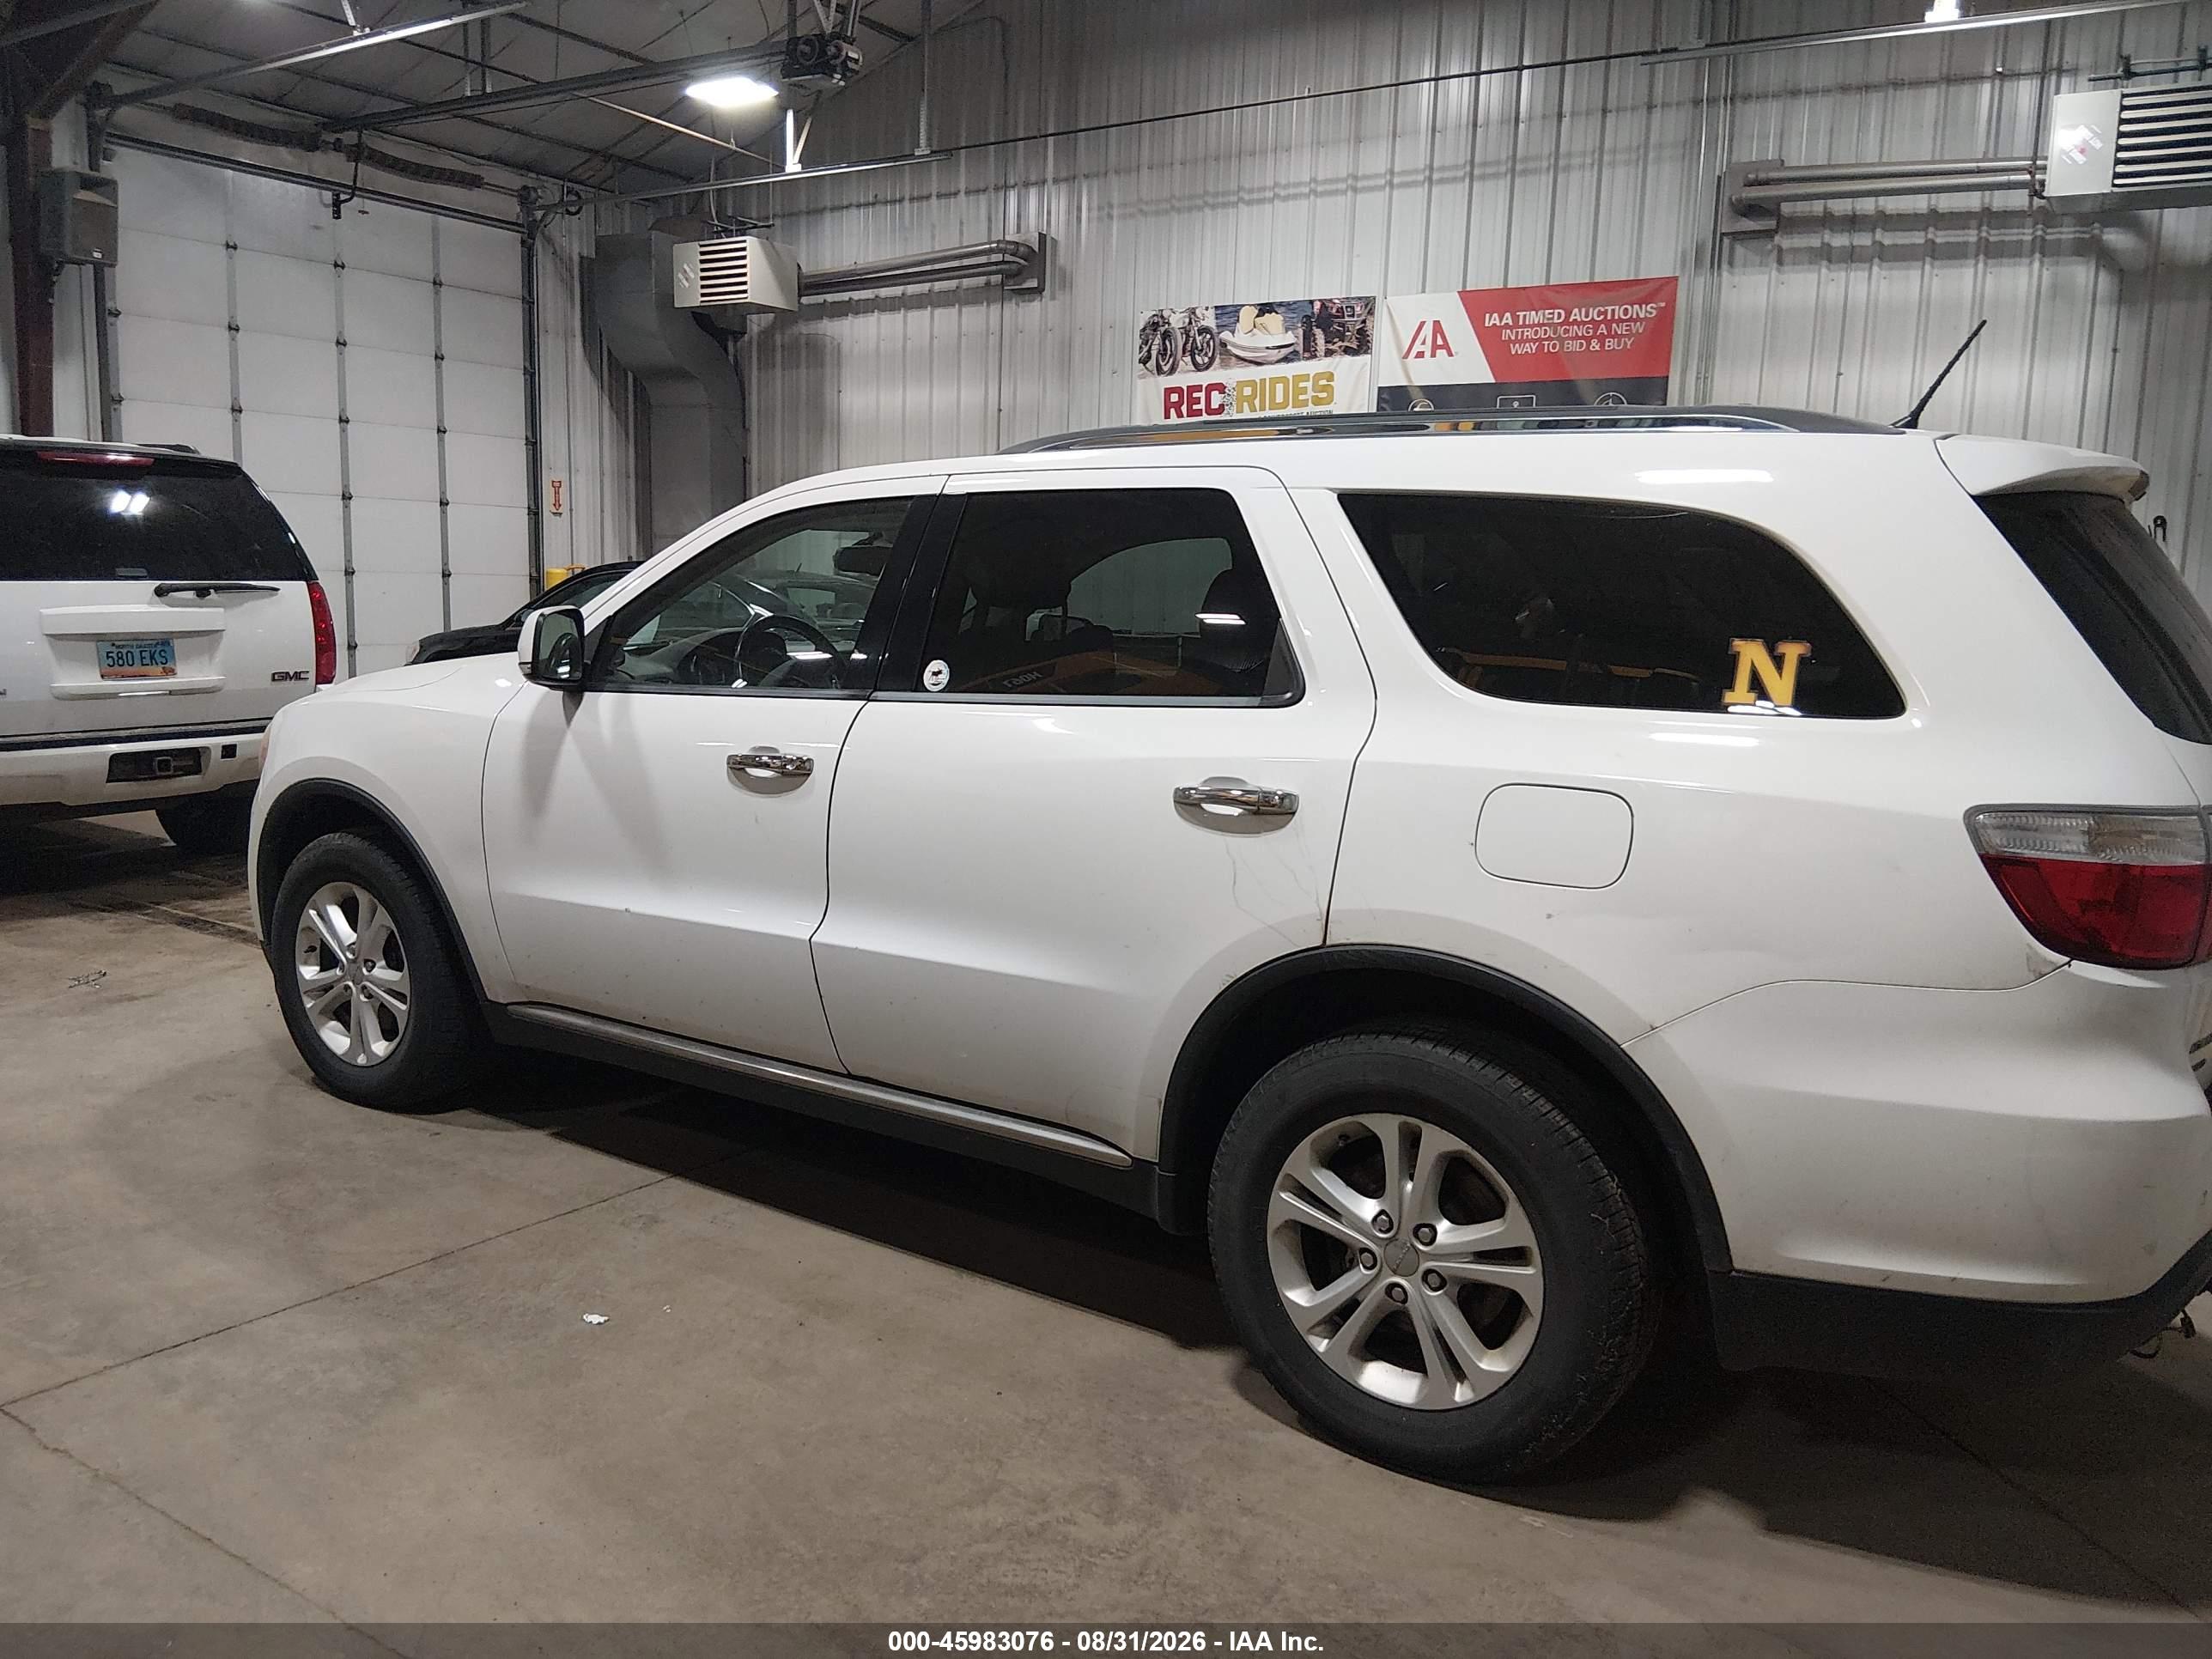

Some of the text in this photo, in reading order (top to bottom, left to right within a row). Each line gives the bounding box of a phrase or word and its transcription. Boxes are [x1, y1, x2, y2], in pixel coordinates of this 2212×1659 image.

[1485, 312, 1513, 327] IAA
[1516, 309, 1565, 325] TIMED
[1501, 321, 1646, 341] INTRODUCING A NEW
[1510, 337, 1635, 355] WAY TO BID & BUY
[1164, 370, 1335, 420] REC RIDES
[106, 648, 168, 667] 580 EKS
[271, 670, 310, 682] GMC
[1722, 638, 1813, 707] N
